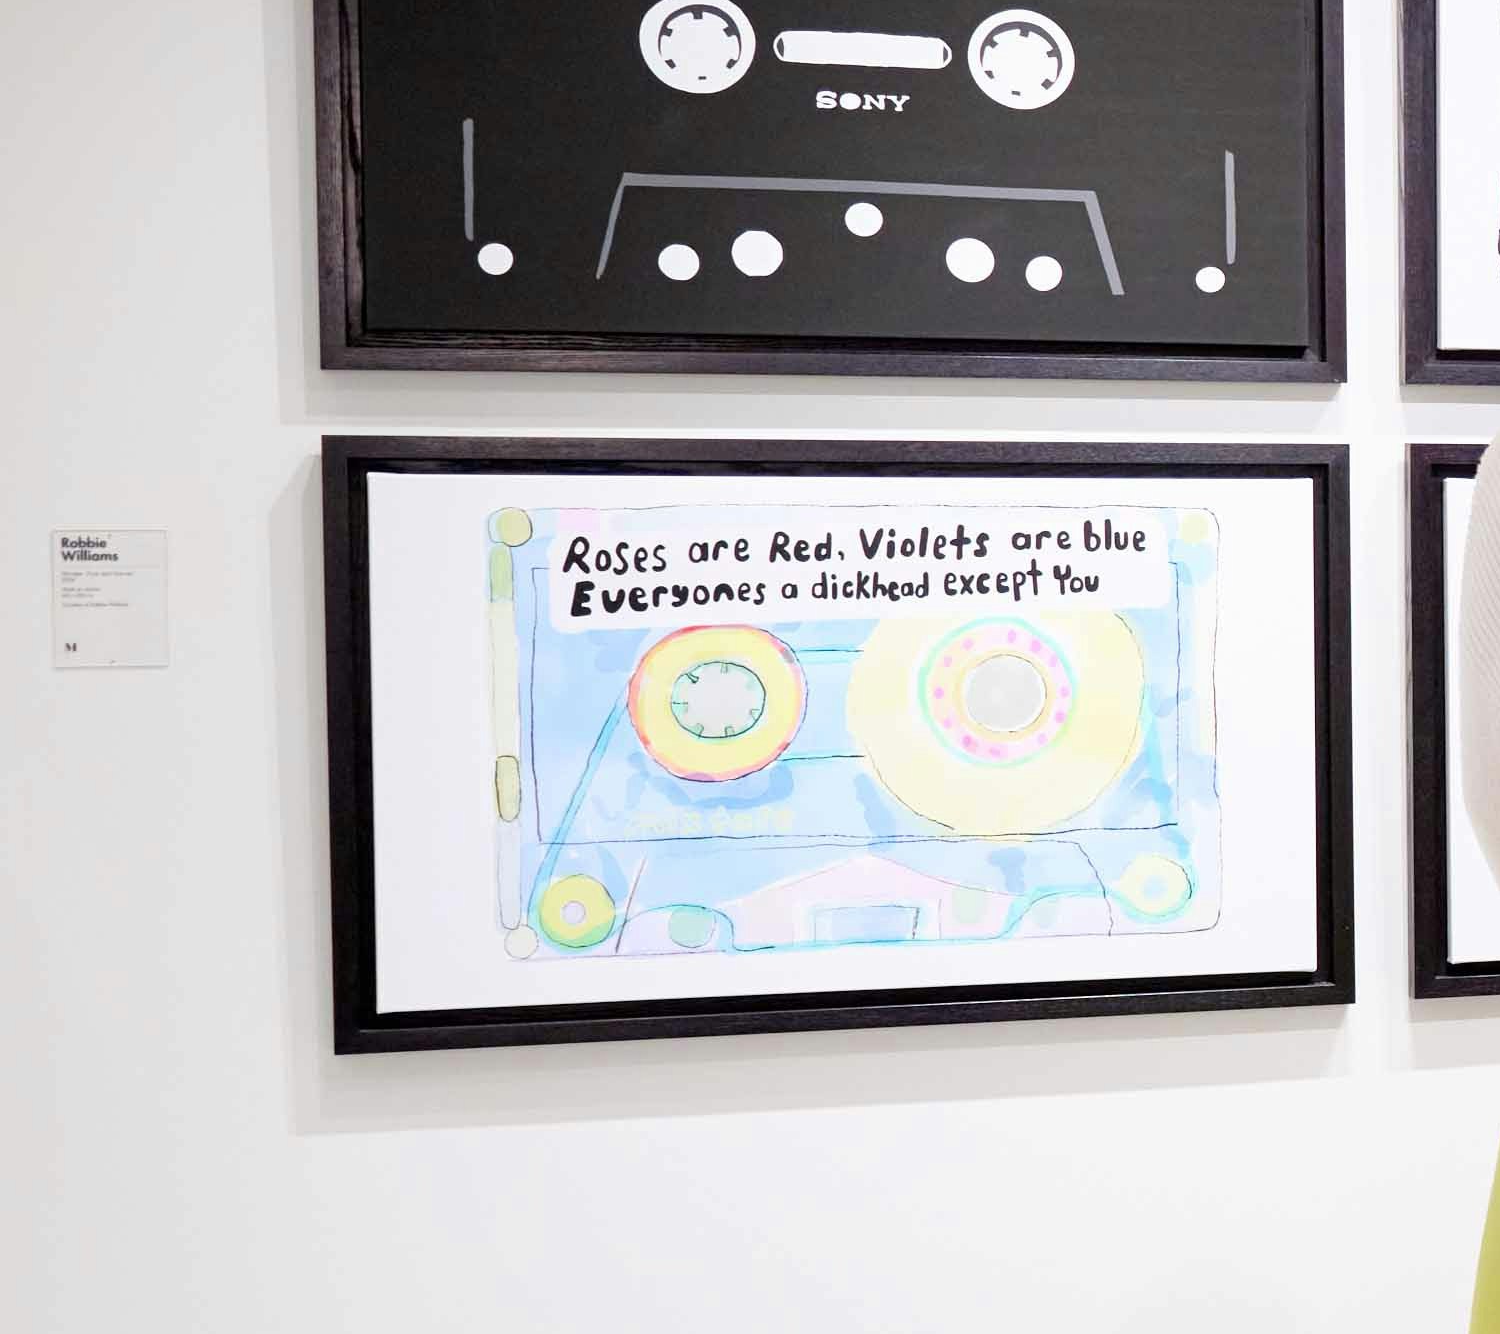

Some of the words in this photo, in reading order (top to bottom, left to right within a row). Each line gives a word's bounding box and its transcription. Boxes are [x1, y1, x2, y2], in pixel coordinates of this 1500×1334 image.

[816, 90, 910, 112] SONY
[61, 536, 107, 548] Robbie
[562, 536, 667, 576] Roses
[688, 538, 750, 564] are
[769, 531, 845, 563] Red,
[859, 524, 990, 560] Violets
[1011, 530, 1072, 551] are
[1083, 518, 1146, 552] blue
[61, 549, 119, 561] Williams
[570, 580, 766, 617] Everyones
[781, 583, 798, 600] a
[811, 570, 929, 602] dickhead
[943, 558, 1043, 602] except
[1053, 564, 1099, 596] You
